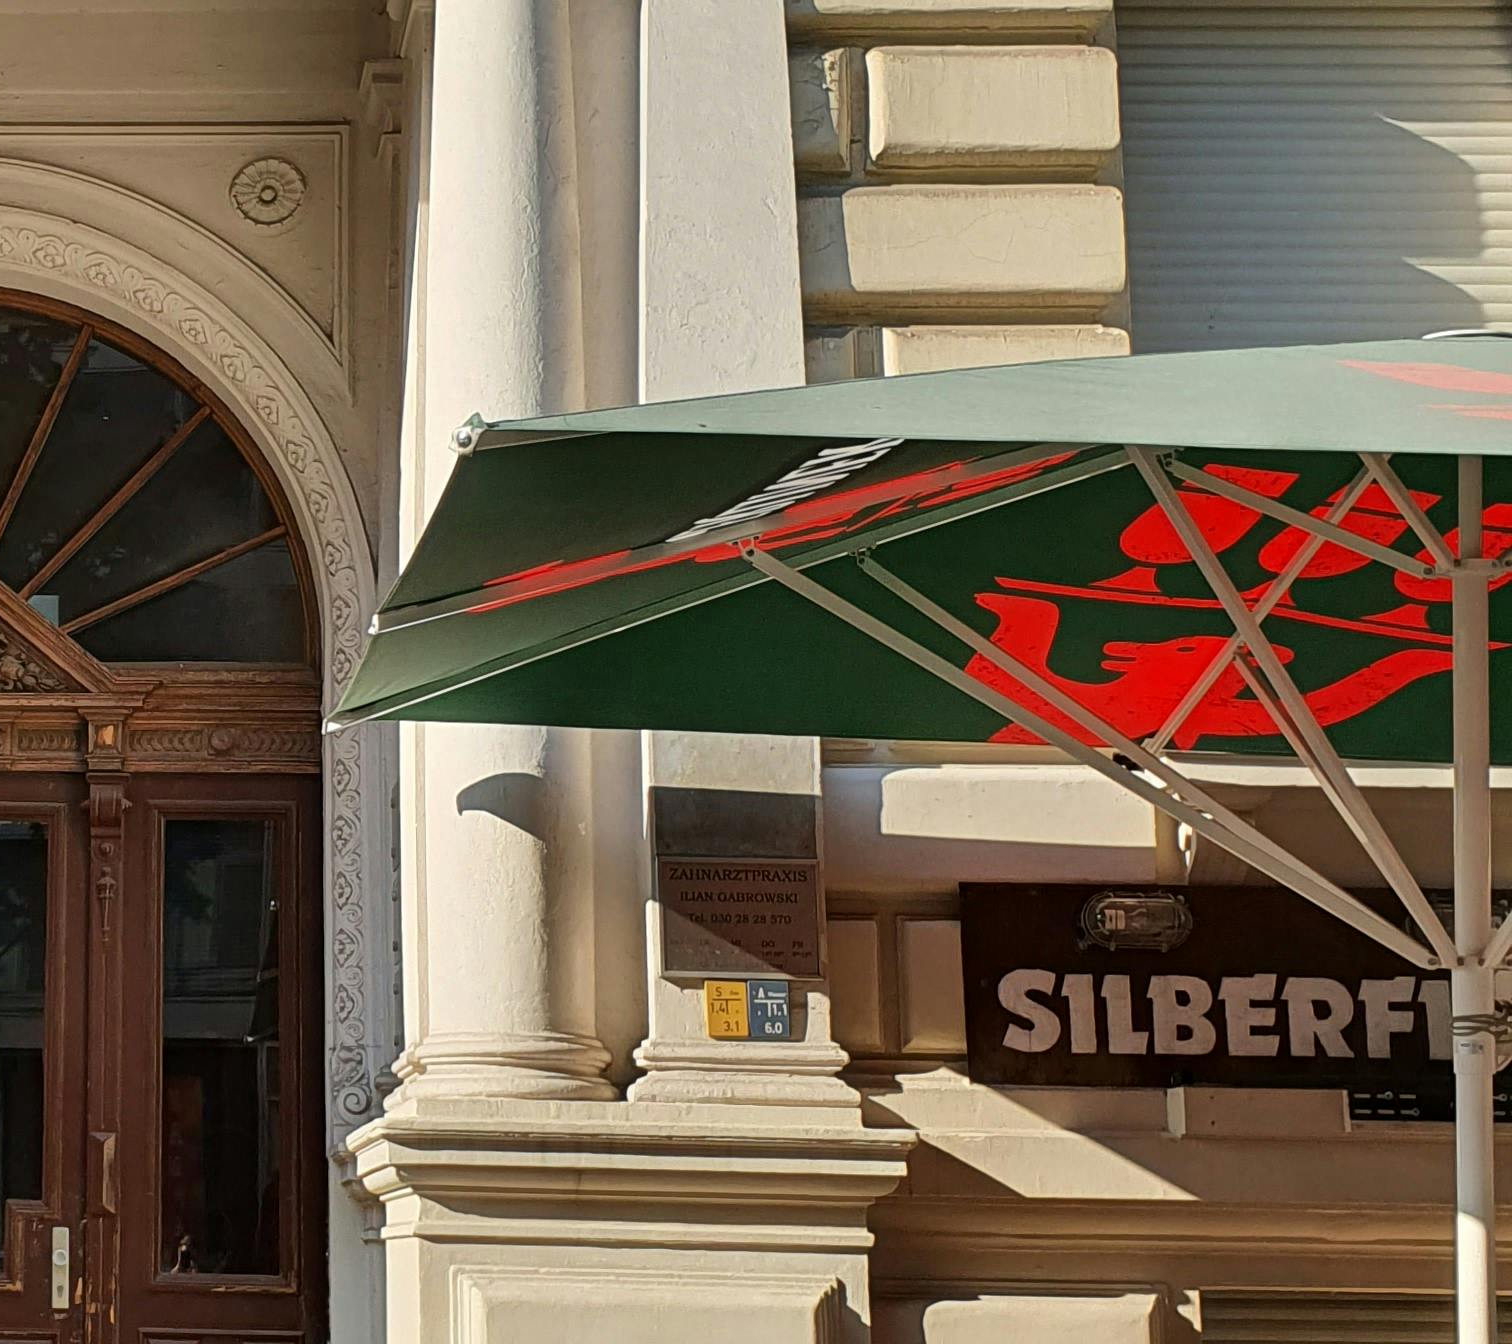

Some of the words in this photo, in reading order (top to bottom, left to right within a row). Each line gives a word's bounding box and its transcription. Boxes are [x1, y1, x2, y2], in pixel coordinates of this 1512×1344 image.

[669, 868, 808, 883] ZAHNARZTPRAXIS
[680, 891, 714, 902] ILIAN
[717, 892, 798, 904] GABROWSKI
[711, 913, 732, 925] 030
